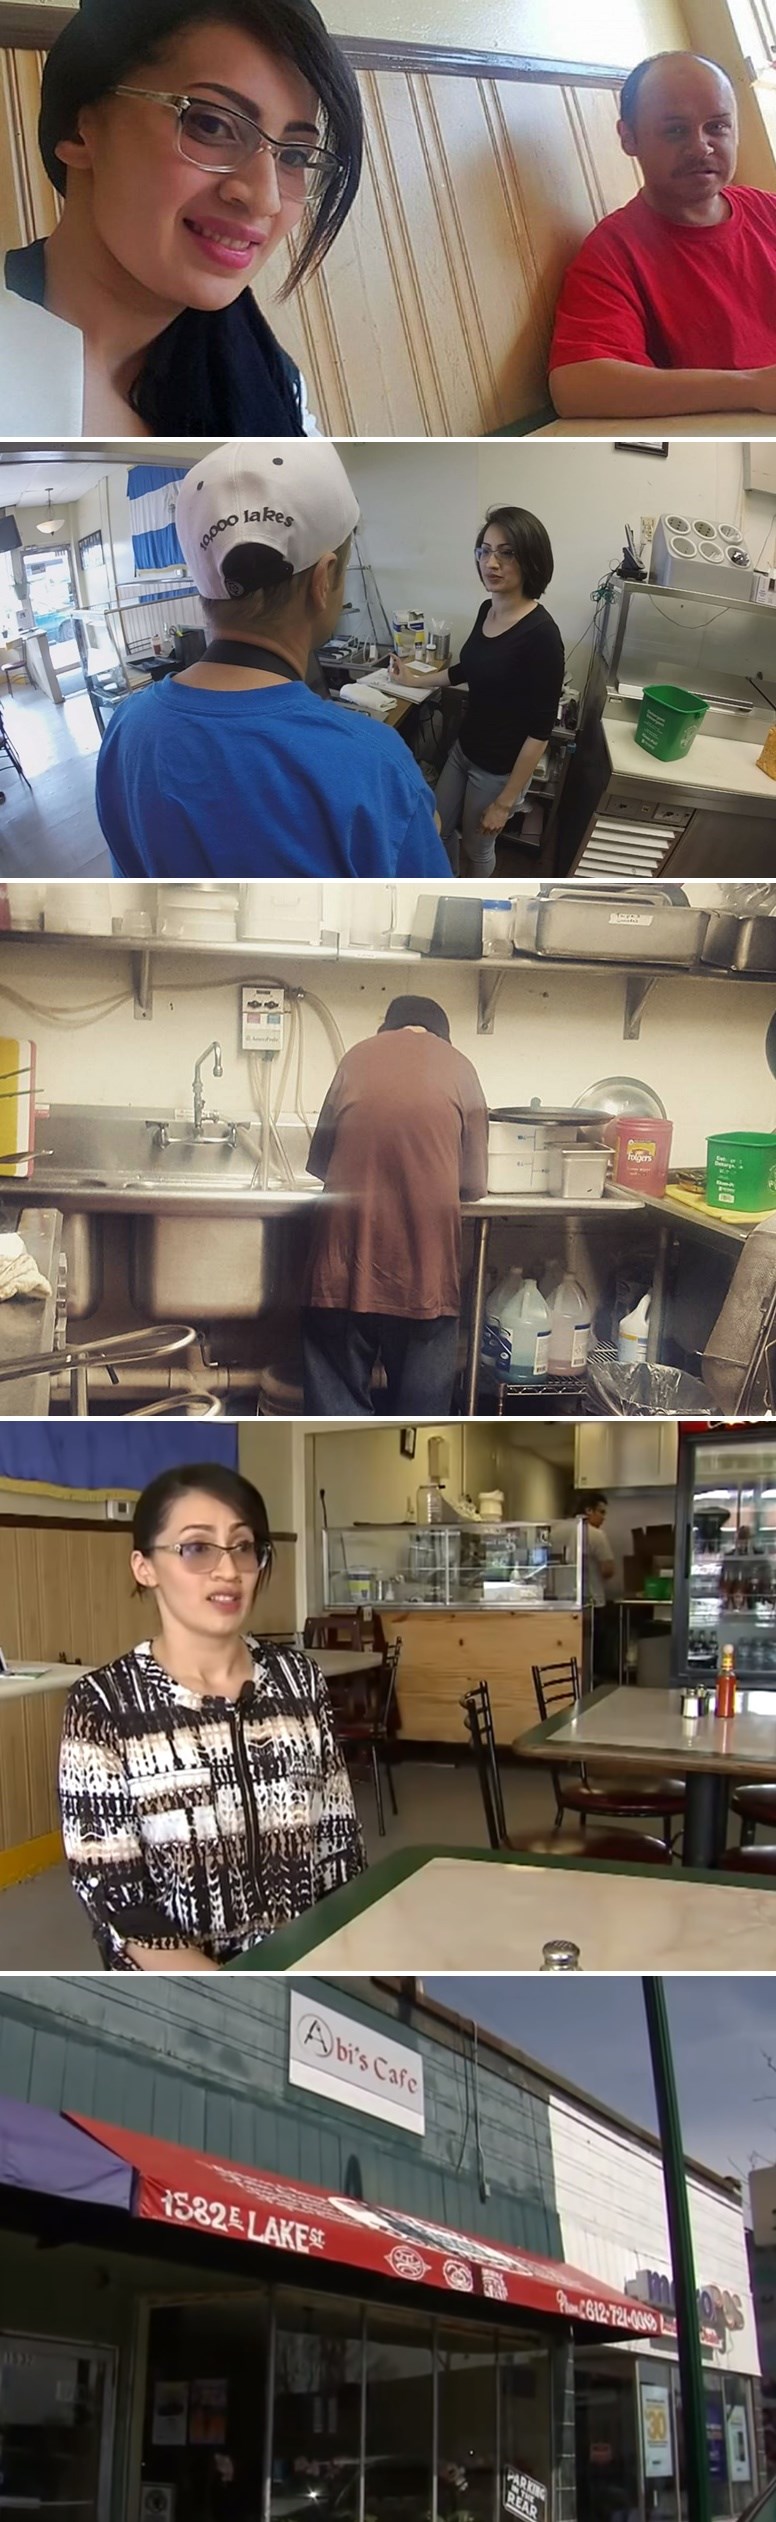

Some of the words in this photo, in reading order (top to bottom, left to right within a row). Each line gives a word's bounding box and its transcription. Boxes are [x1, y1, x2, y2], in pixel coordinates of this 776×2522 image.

[200, 515, 239, 551] 10,000
[243, 507, 295, 528] lakes
[627, 1151, 652, 1163] Folgers
[303, 2019, 369, 2072] Abi's
[373, 2057, 418, 2094] Cafe
[247, 2210, 310, 2254] LAKE
[507, 2470, 547, 2501] PARKING
[520, 2489, 535, 2503] THE
[507, 2490, 538, 2520] REAR
